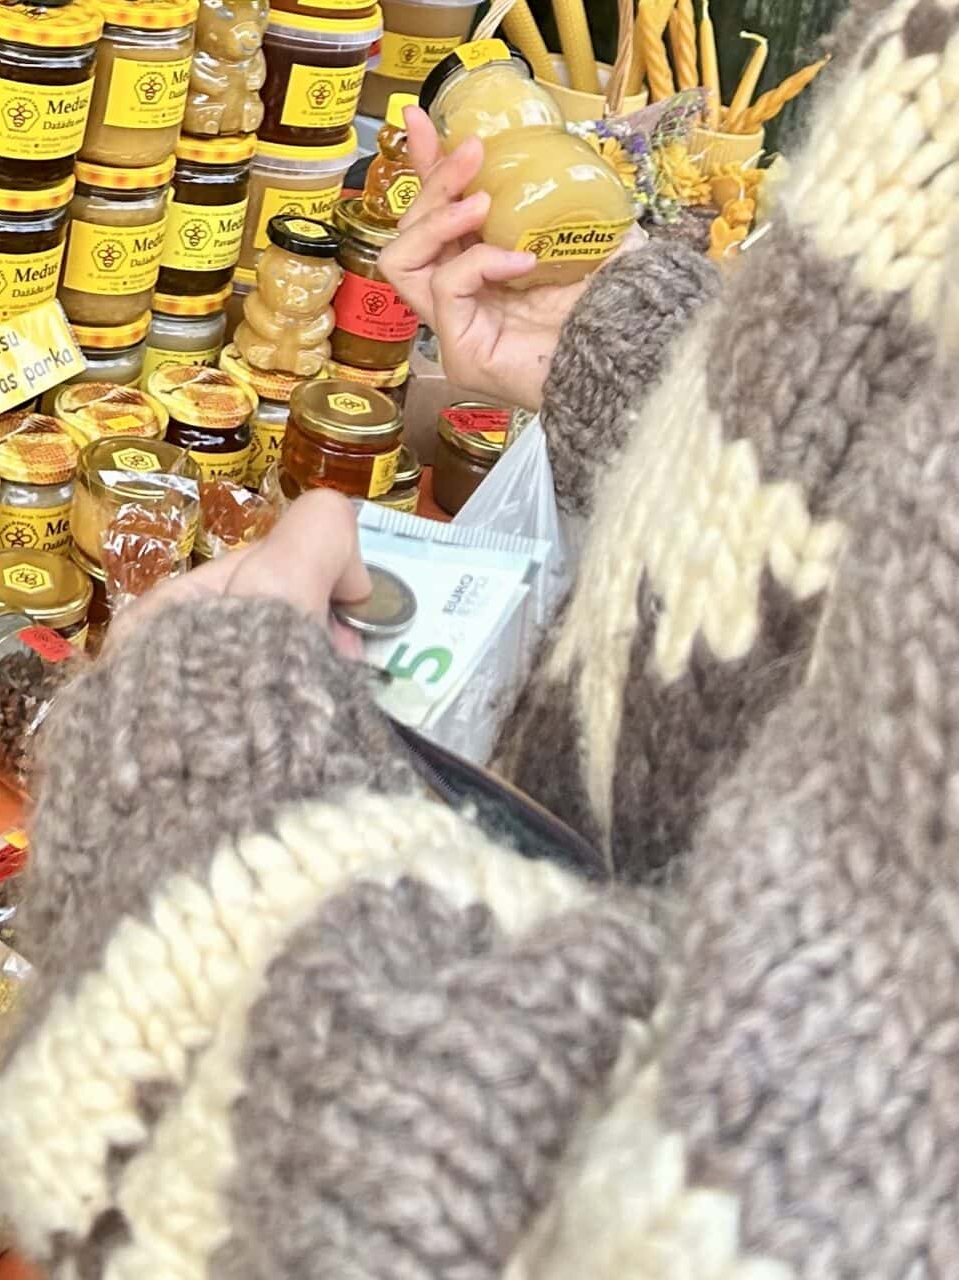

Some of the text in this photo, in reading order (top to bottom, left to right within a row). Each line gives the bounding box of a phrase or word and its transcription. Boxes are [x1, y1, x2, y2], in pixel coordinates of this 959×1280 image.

[554, 229, 616, 246] Medus
[23, 344, 75, 389] parka
[441, 573, 474, 616] EURO
[386, 642, 454, 685] 5
